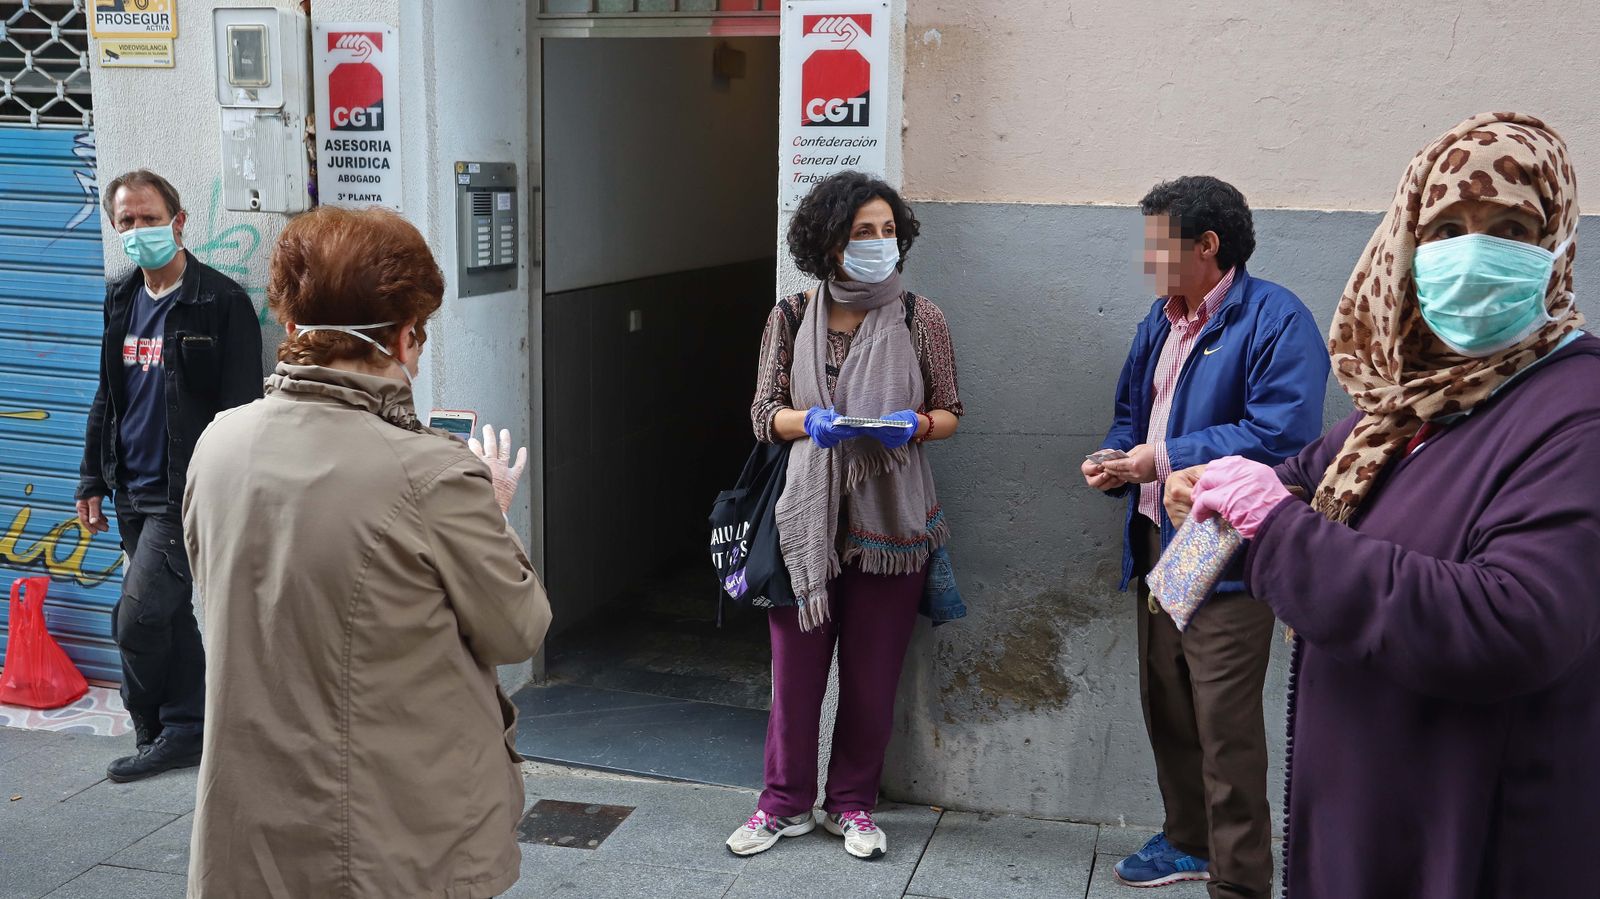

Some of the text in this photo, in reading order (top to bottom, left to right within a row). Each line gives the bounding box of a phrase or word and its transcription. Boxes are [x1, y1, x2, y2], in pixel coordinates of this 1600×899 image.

[96, 13, 169, 25] PROSEGUR
[806, 97, 866, 122] CGT
[333, 106, 381, 127] CGT
[325, 139, 392, 152] ASESORIA
[792, 135, 877, 147] Confederación
[327, 156, 391, 169] JURIDICA
[792, 154, 861, 166] General del
[338, 174, 381, 184] ABOGADO
[348, 193, 382, 202] PLANTA
